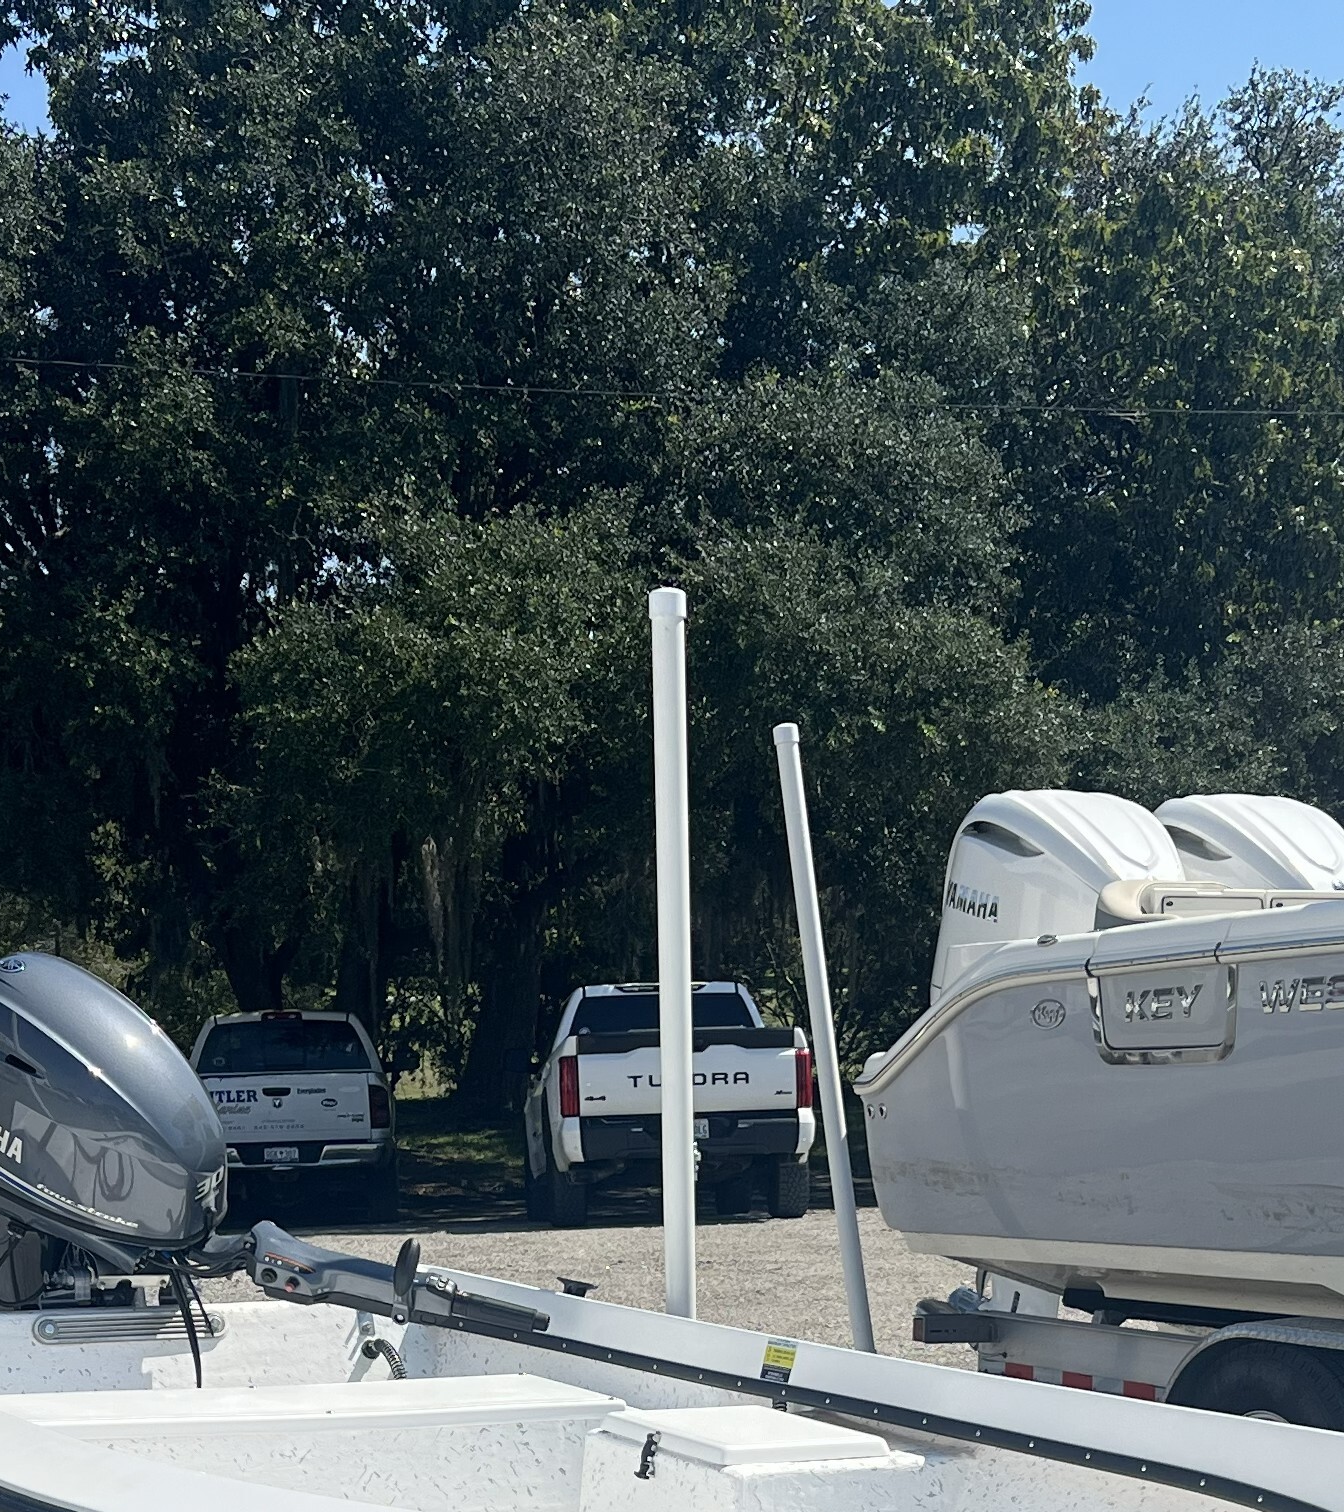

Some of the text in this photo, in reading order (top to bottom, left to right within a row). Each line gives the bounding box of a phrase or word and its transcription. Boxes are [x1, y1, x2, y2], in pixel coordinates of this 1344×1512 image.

[946, 880, 999, 922] YAMAHA
[1124, 983, 1203, 1023] KEY
[627, 1071, 750, 1088] TUDRA
[195, 1164, 225, 1200] 30
